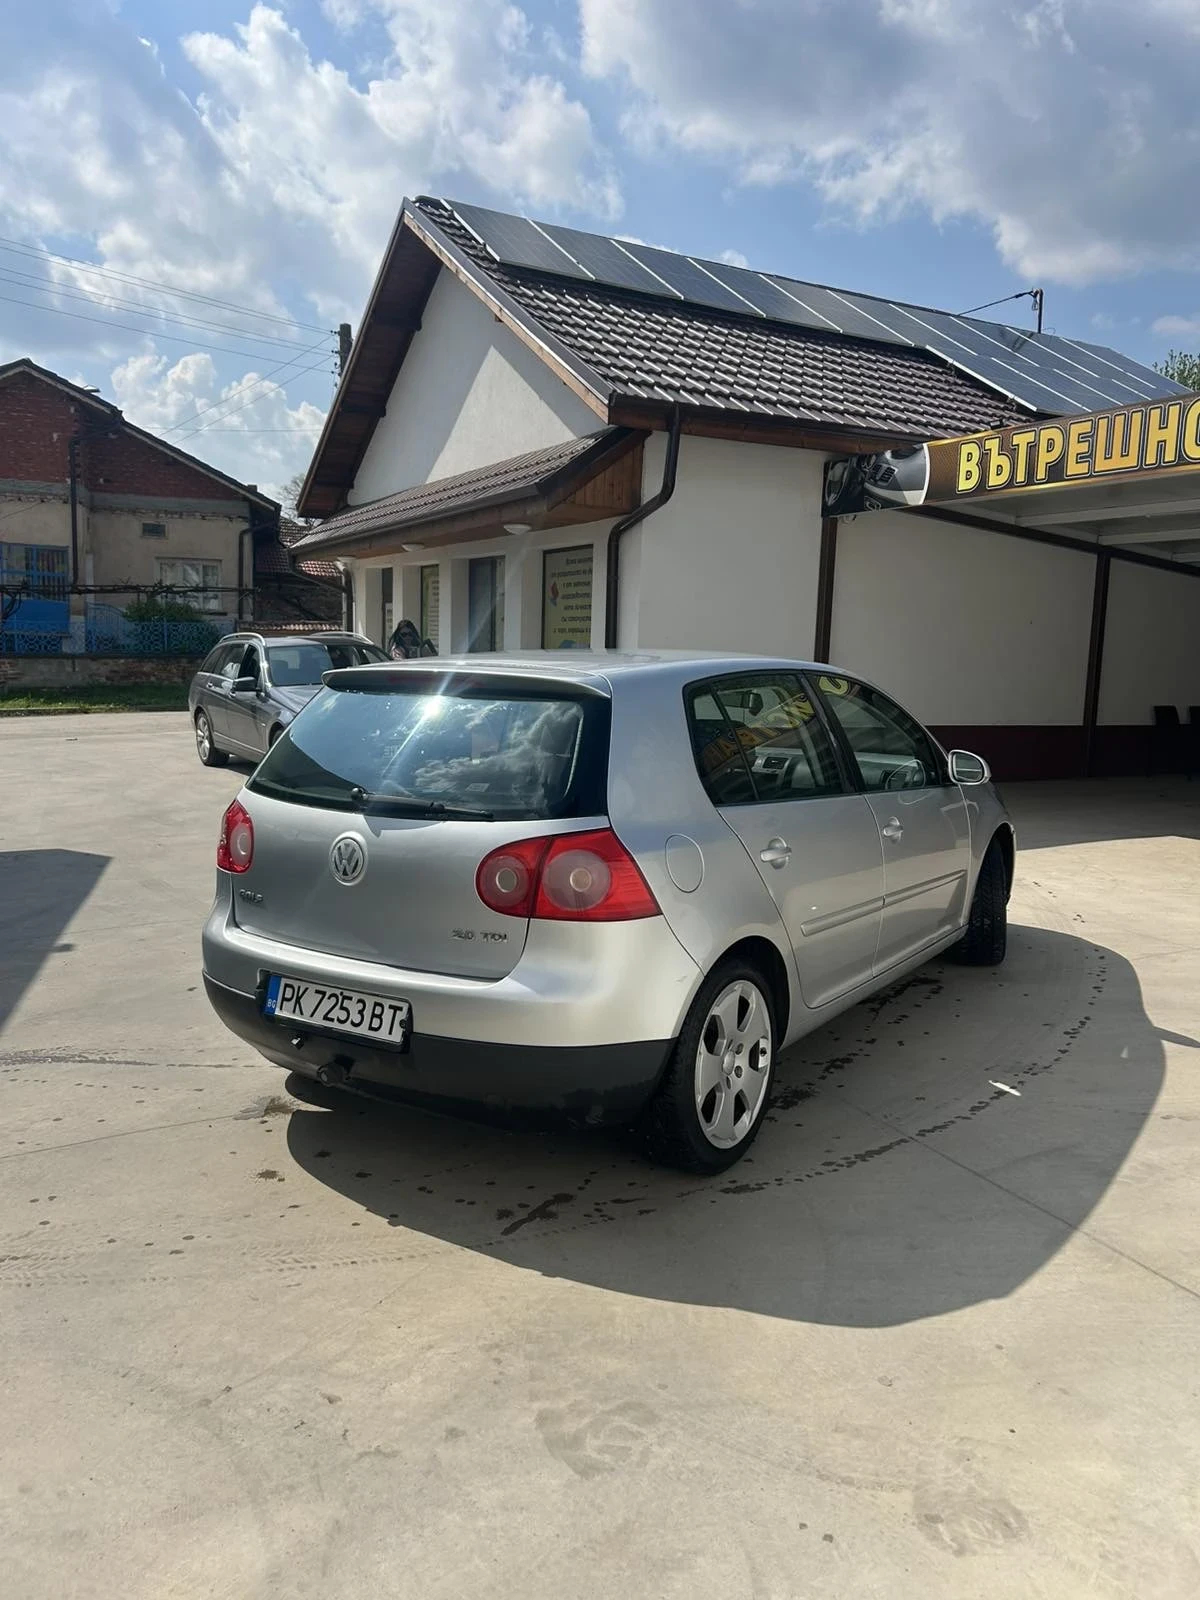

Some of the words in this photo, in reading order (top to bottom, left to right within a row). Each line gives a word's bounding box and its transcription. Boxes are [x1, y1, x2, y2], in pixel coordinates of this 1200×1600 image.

[266, 997, 276, 1009] BG
[279, 983, 309, 1016] PK
[309, 989, 367, 1028] 7253
[368, 1001, 403, 1036] BT
